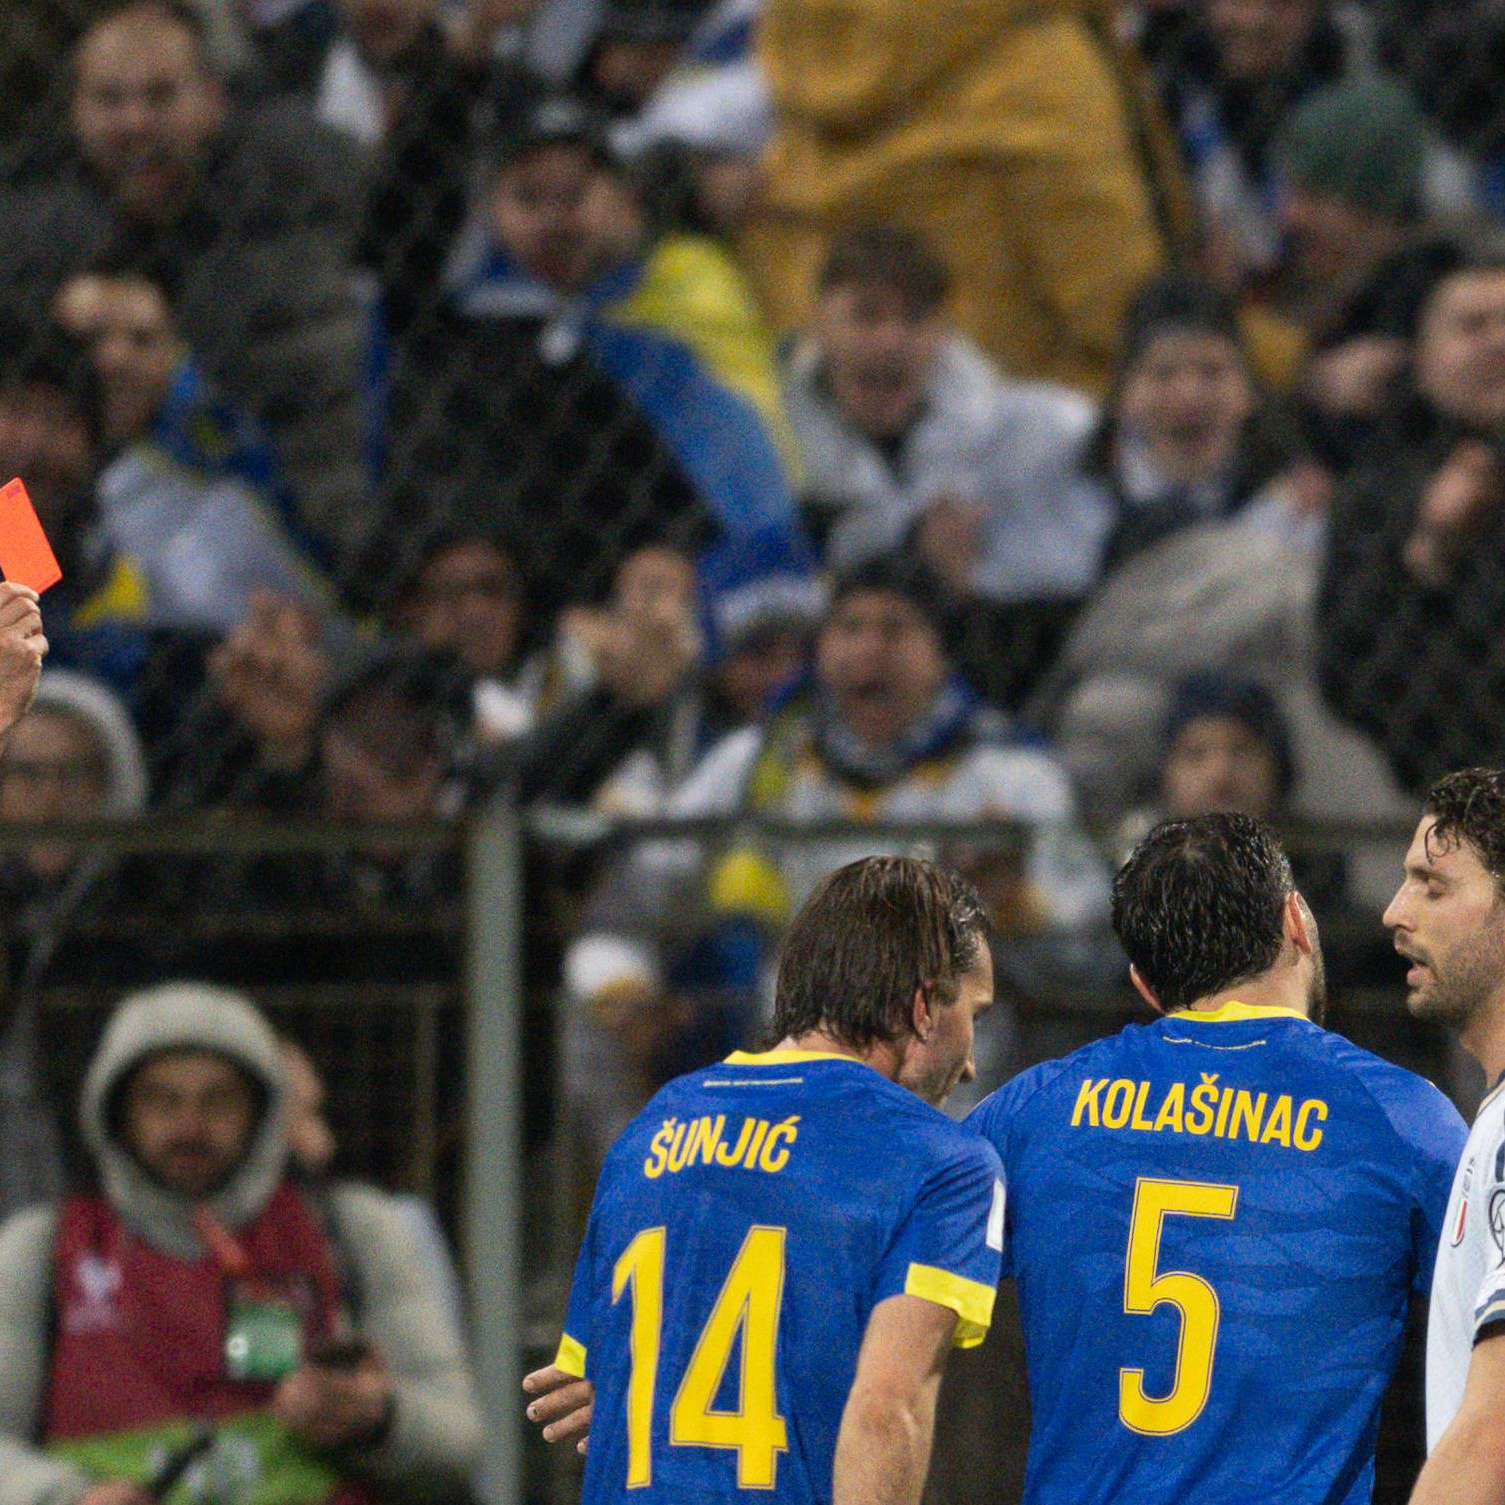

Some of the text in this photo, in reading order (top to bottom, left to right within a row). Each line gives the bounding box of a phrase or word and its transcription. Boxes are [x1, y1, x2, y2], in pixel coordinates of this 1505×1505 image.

[644, 1115, 801, 1178] ŠUNJIĆ
[1071, 1072, 1328, 1151] KOLAŠINAC
[612, 1225, 789, 1490] 14
[1119, 1177, 1239, 1436] 5
